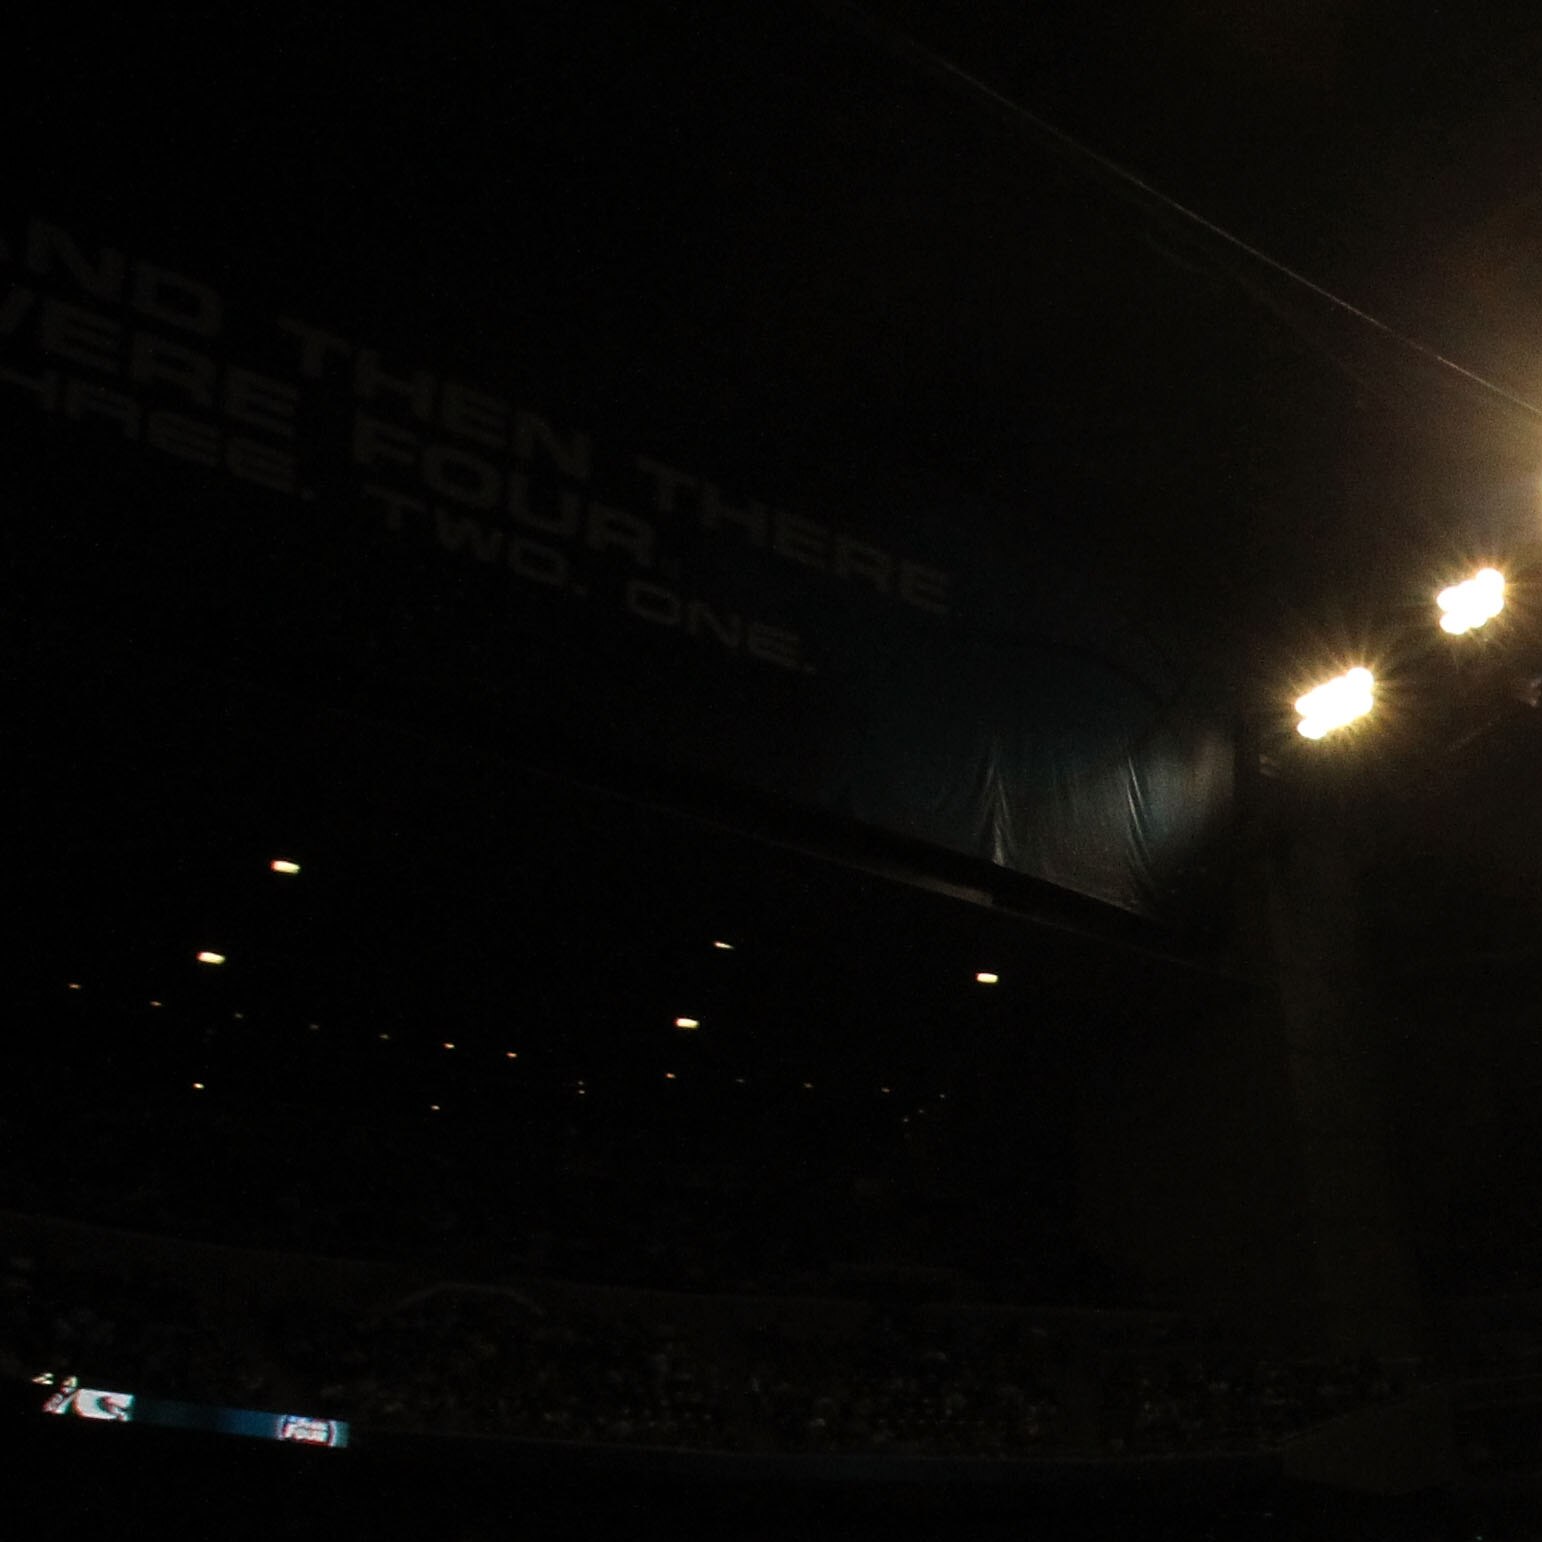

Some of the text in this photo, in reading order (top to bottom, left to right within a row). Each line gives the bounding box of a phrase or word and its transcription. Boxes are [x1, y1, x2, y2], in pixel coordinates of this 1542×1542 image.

[0, 216, 952, 616] ND THEN THERE
[0, 367, 317, 503] HREE.
[626, 579, 817, 675] ONE.
